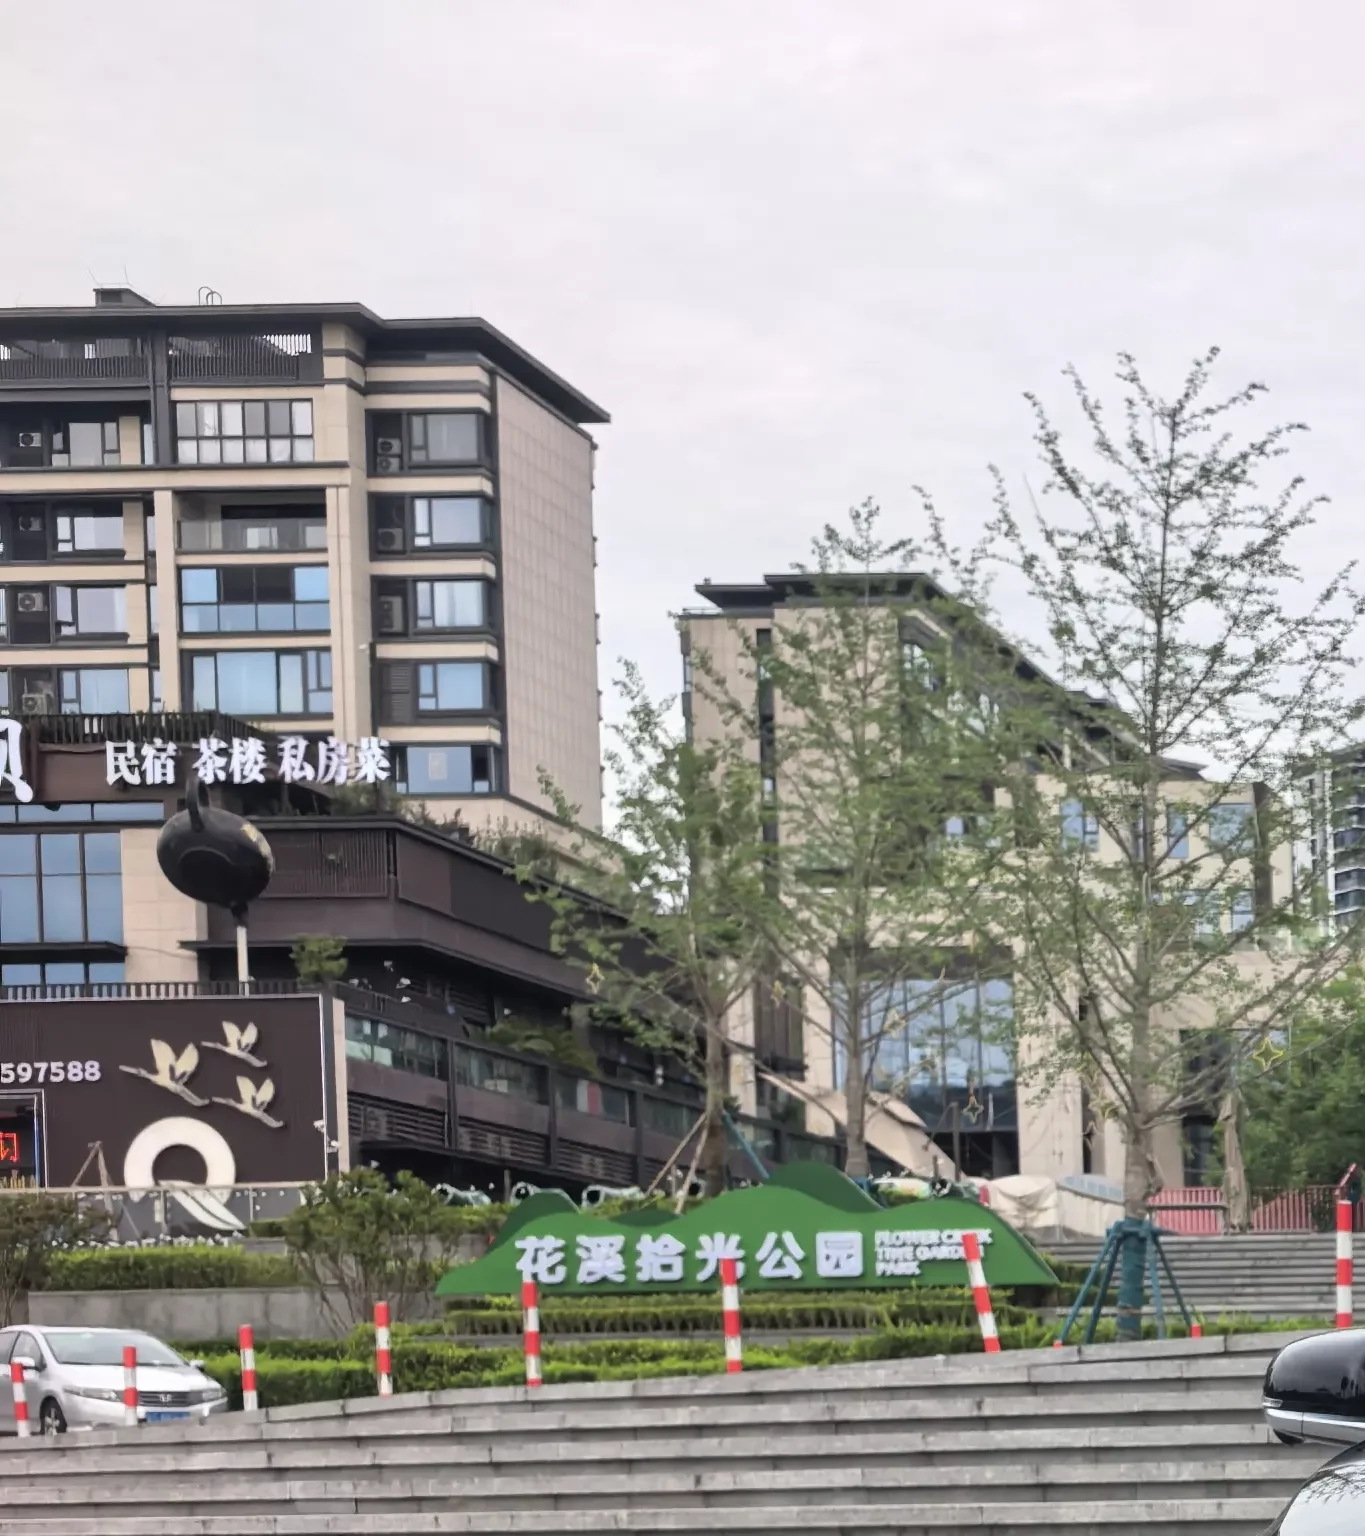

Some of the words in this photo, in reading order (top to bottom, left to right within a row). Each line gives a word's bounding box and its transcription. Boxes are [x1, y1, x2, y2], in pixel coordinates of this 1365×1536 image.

[105, 737, 177, 786] 民宿
[192, 736, 267, 785] 茶楼
[277, 735, 391, 785] 私房菜
[0, 1060, 101, 1083] 597588
[515, 1231, 864, 1283] 花溪拾光公园
